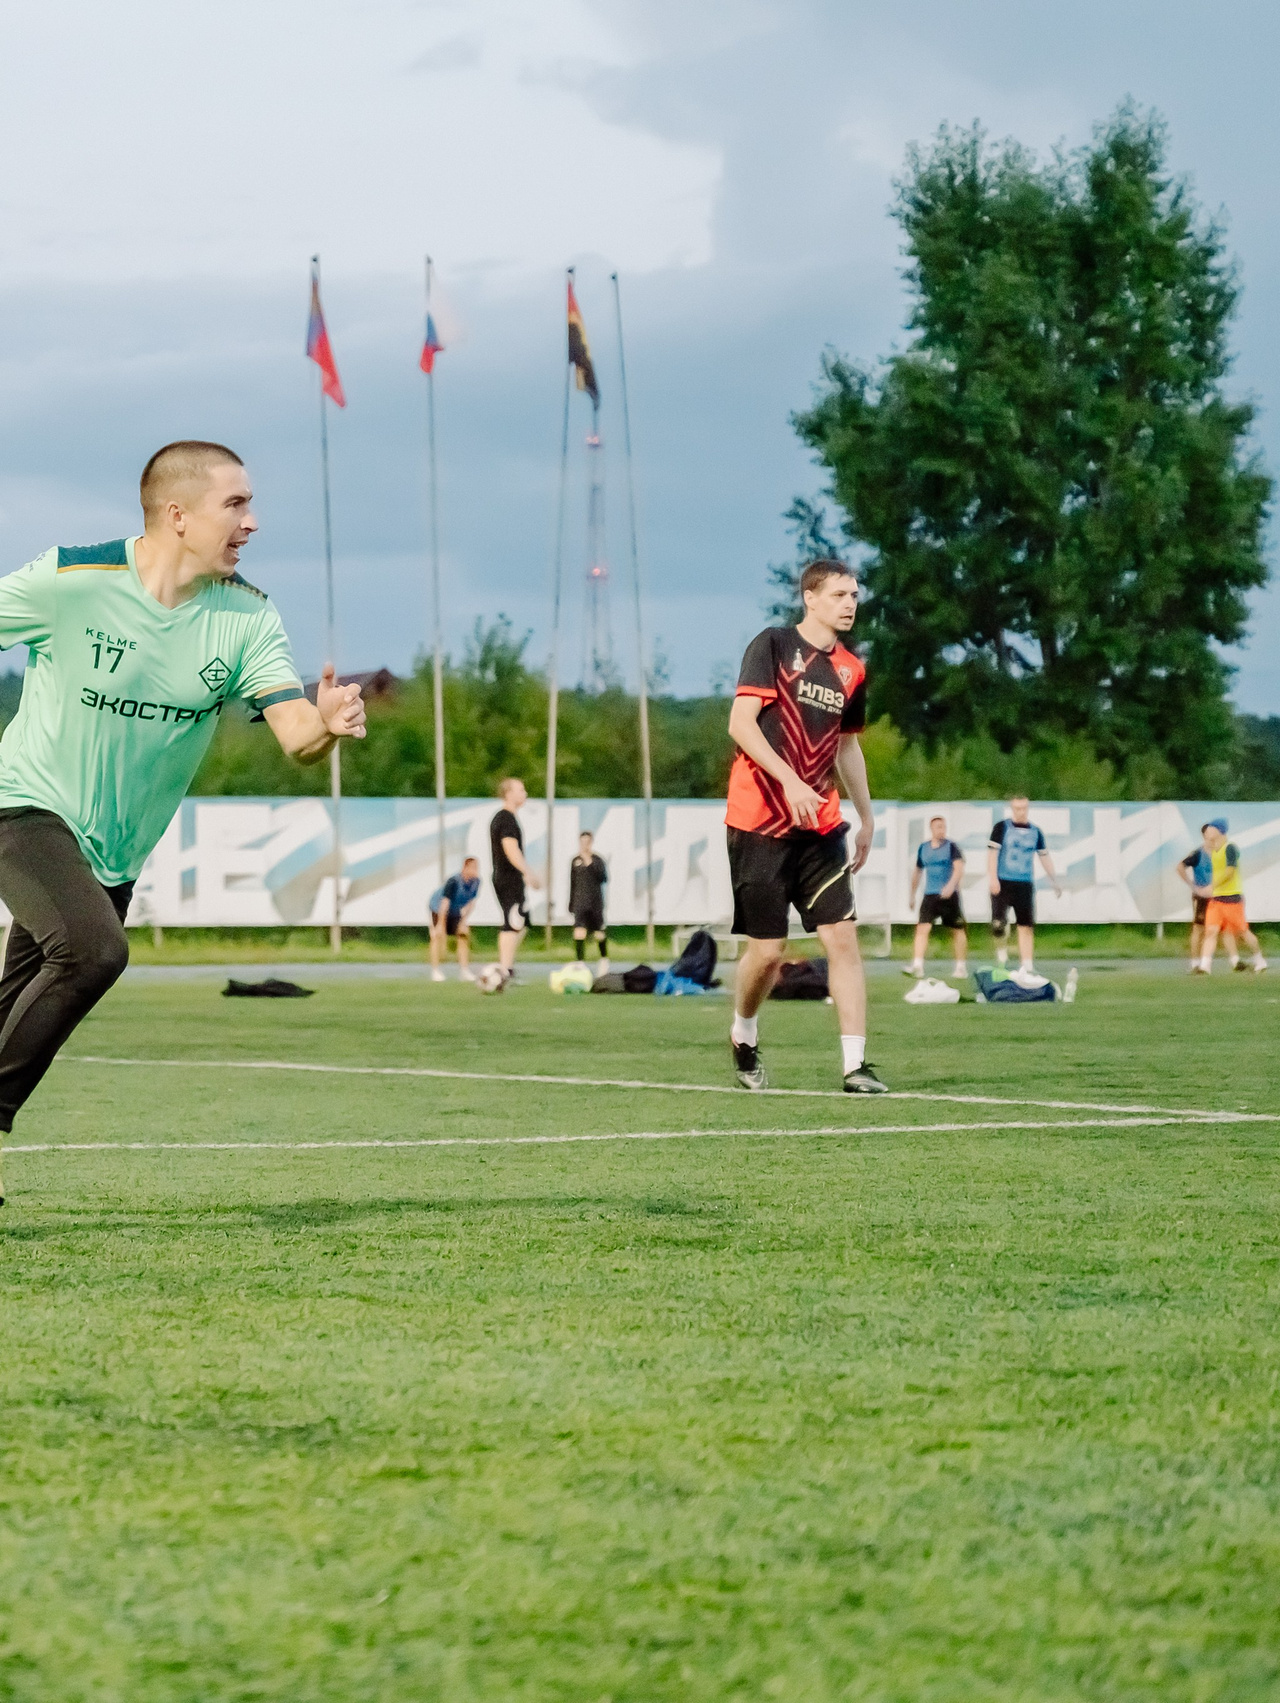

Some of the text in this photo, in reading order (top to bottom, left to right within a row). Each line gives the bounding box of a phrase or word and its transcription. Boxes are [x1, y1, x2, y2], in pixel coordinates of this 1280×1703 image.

[86, 627, 138, 650] KELME
[91, 643, 125, 673] 17
[798, 680, 845, 709] НЛВЗ
